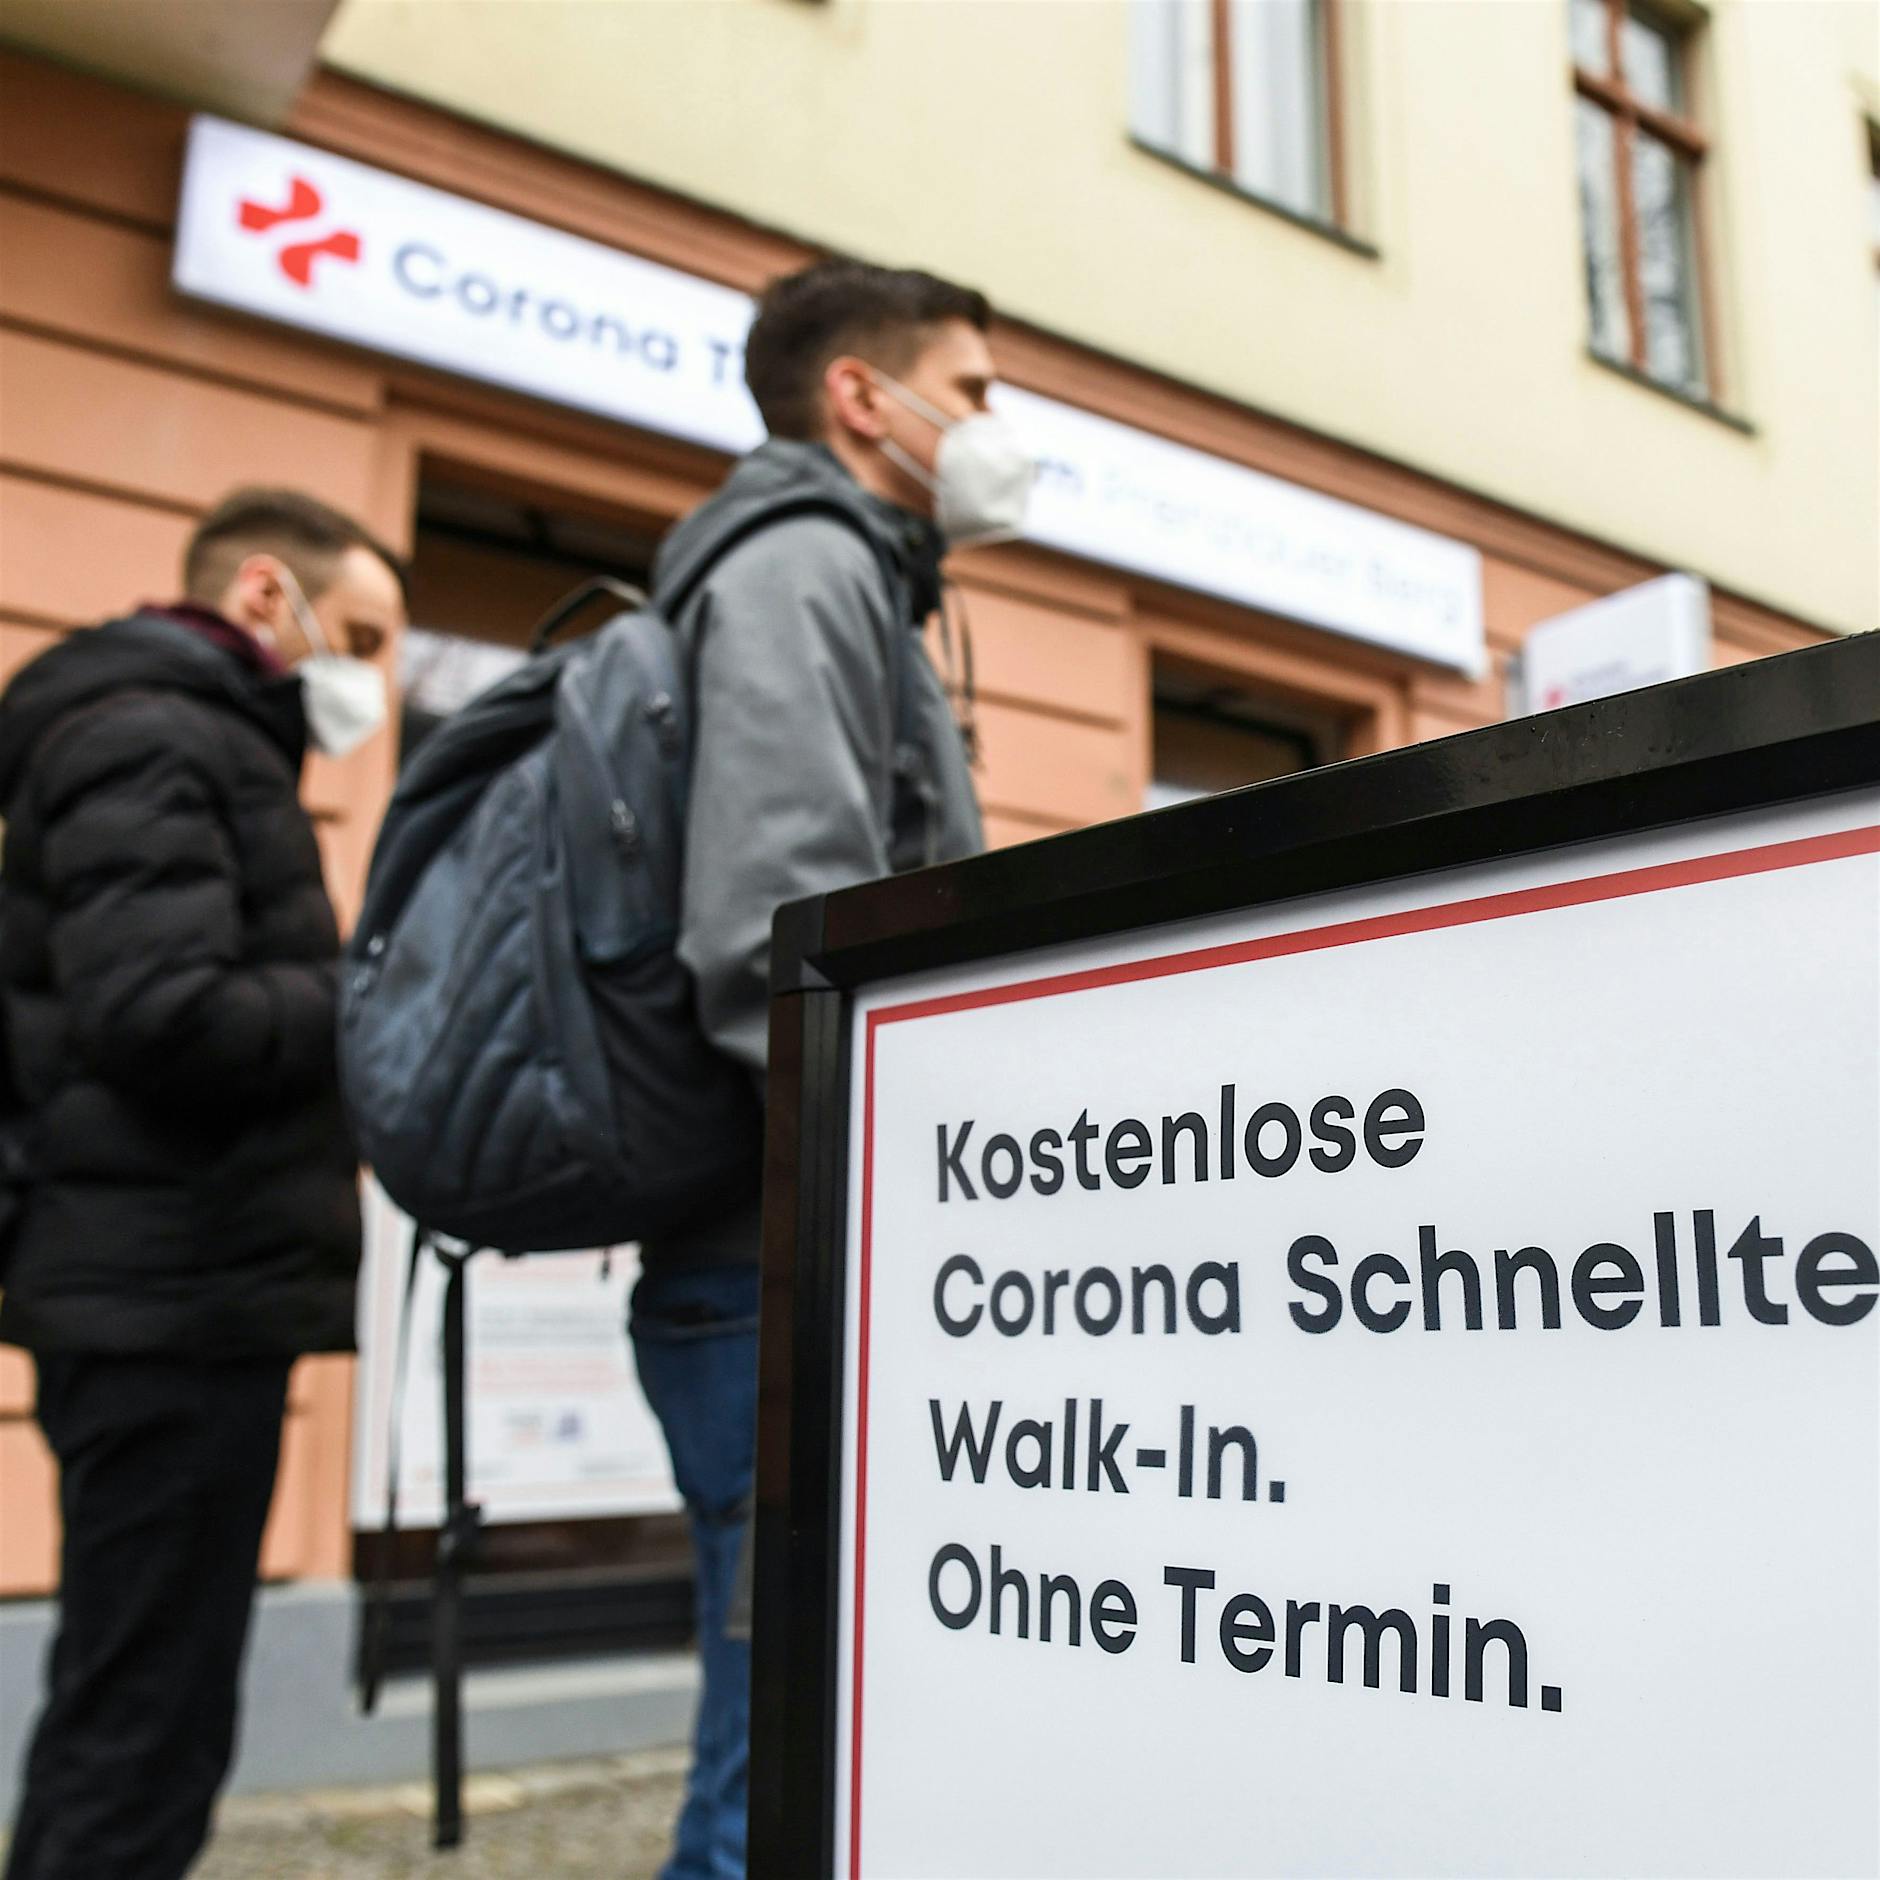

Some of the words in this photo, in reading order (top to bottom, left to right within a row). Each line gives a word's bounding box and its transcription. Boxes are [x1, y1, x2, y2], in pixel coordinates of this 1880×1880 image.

[392, 240, 680, 373] Corona
[936, 1083, 1426, 1203] Kostenlose
[933, 1254, 1241, 1338] Corona
[1286, 1208, 1880, 1335] Schnellte
[929, 1398, 1286, 1504] Walk-In.
[928, 1542, 1138, 1655] Ohne
[1163, 1565, 1563, 1714] Termin.
